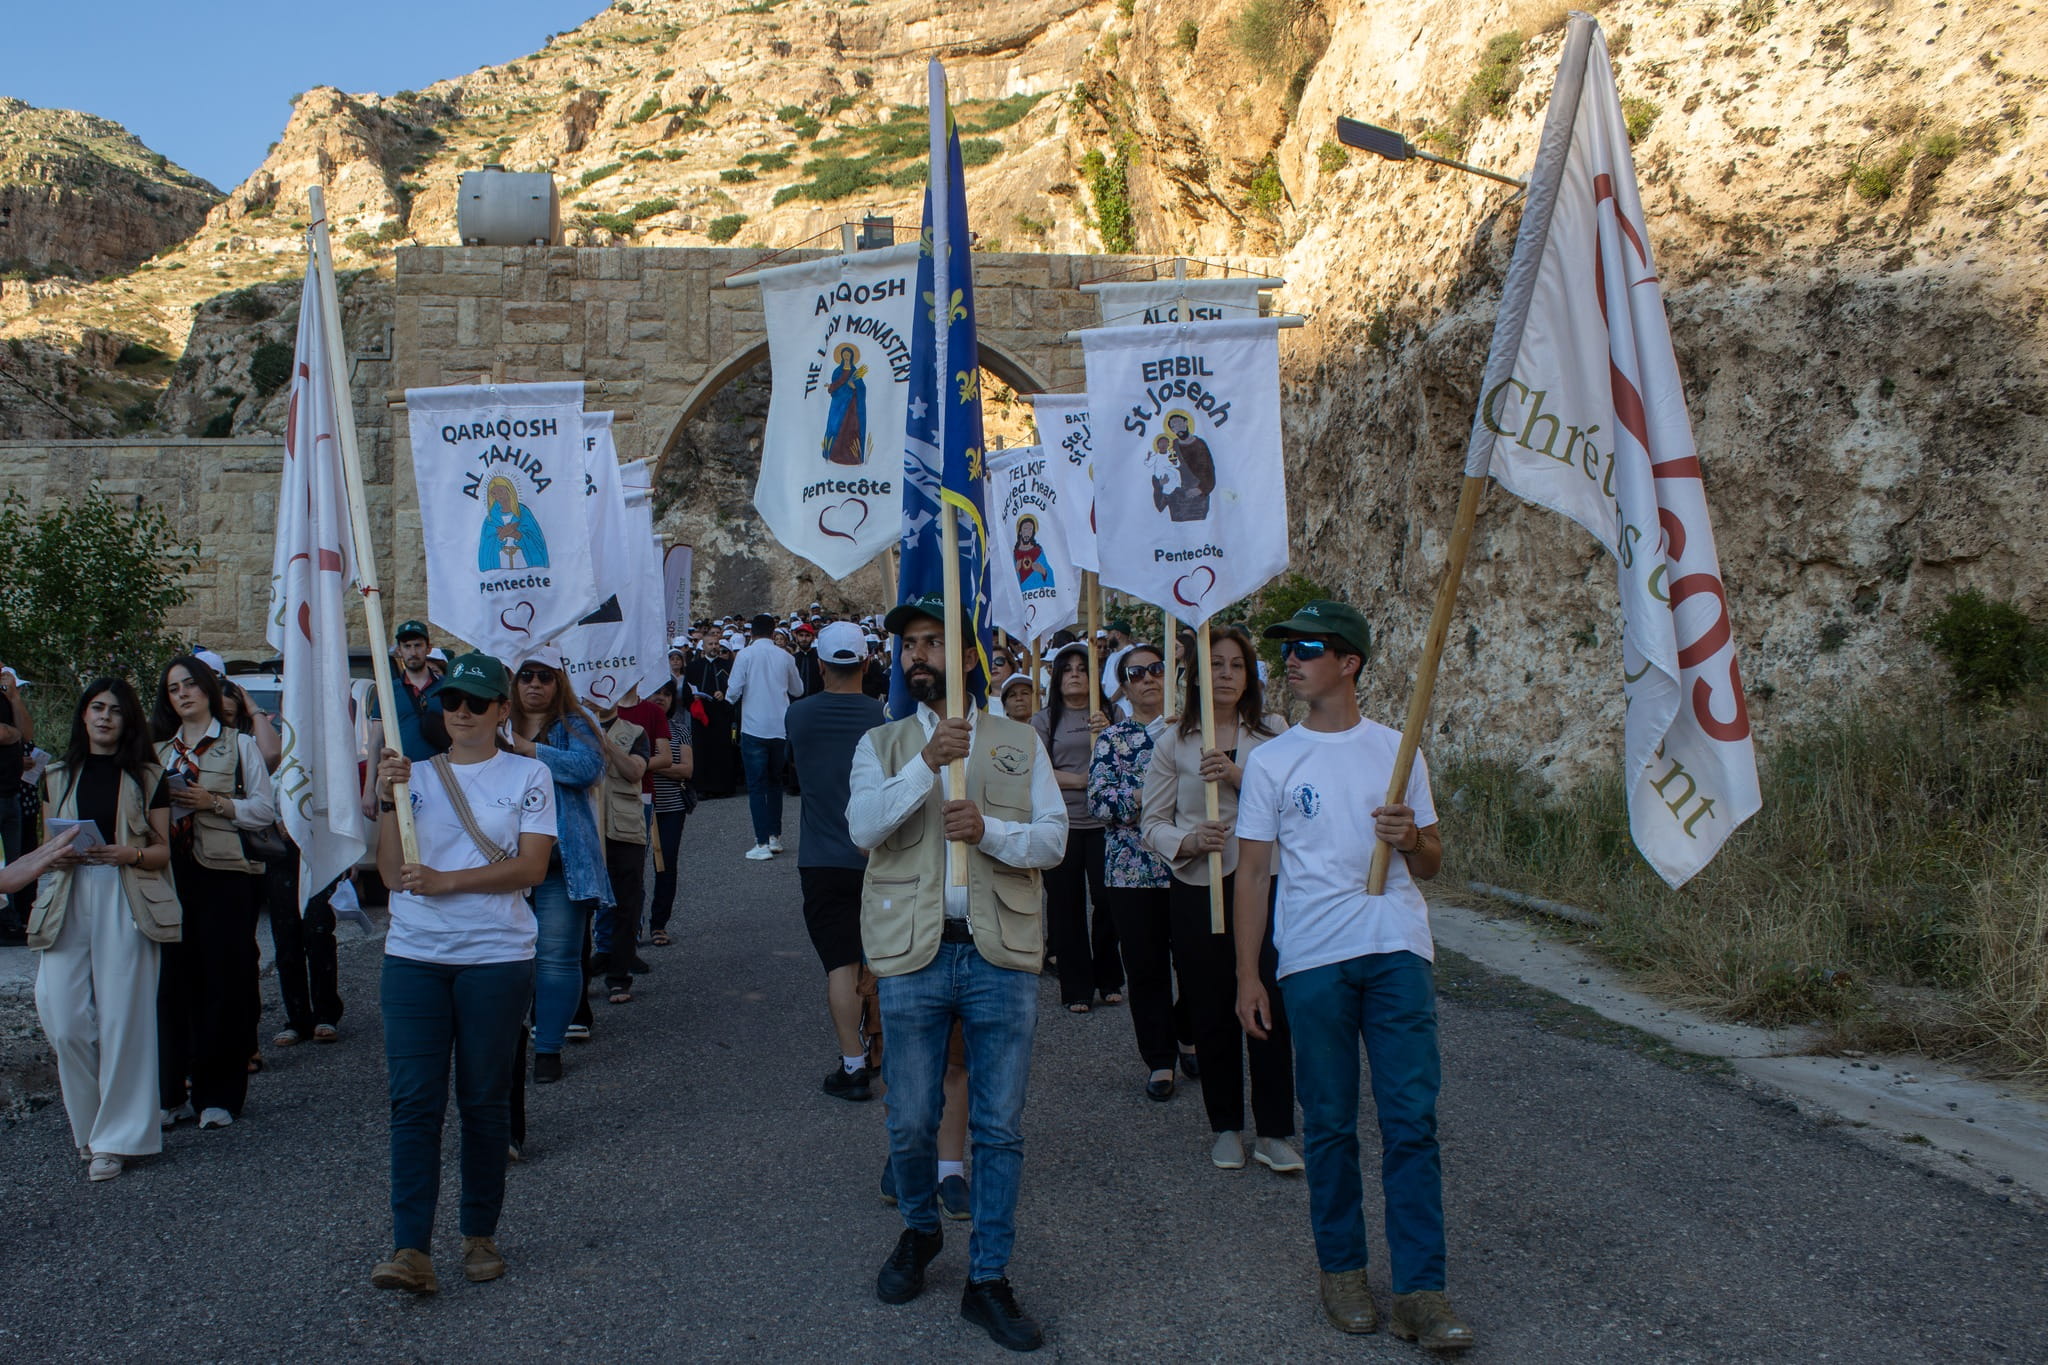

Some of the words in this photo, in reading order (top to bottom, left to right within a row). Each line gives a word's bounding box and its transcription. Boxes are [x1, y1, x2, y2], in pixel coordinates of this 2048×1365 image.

[804, 362, 823, 400] THE
[1142, 356, 1214, 383] ERBIL
[1124, 405, 1152, 437] St
[1146, 379, 1231, 428] Joseph
[442, 418, 557, 445] QARAQOSH
[463, 472, 484, 500] AL
[479, 444, 552, 494] TAHIRA
[1009, 460, 1046, 483] TELKIF
[1154, 544, 1224, 563] Pentecôte
[560, 655, 637, 674] Pentecôte
